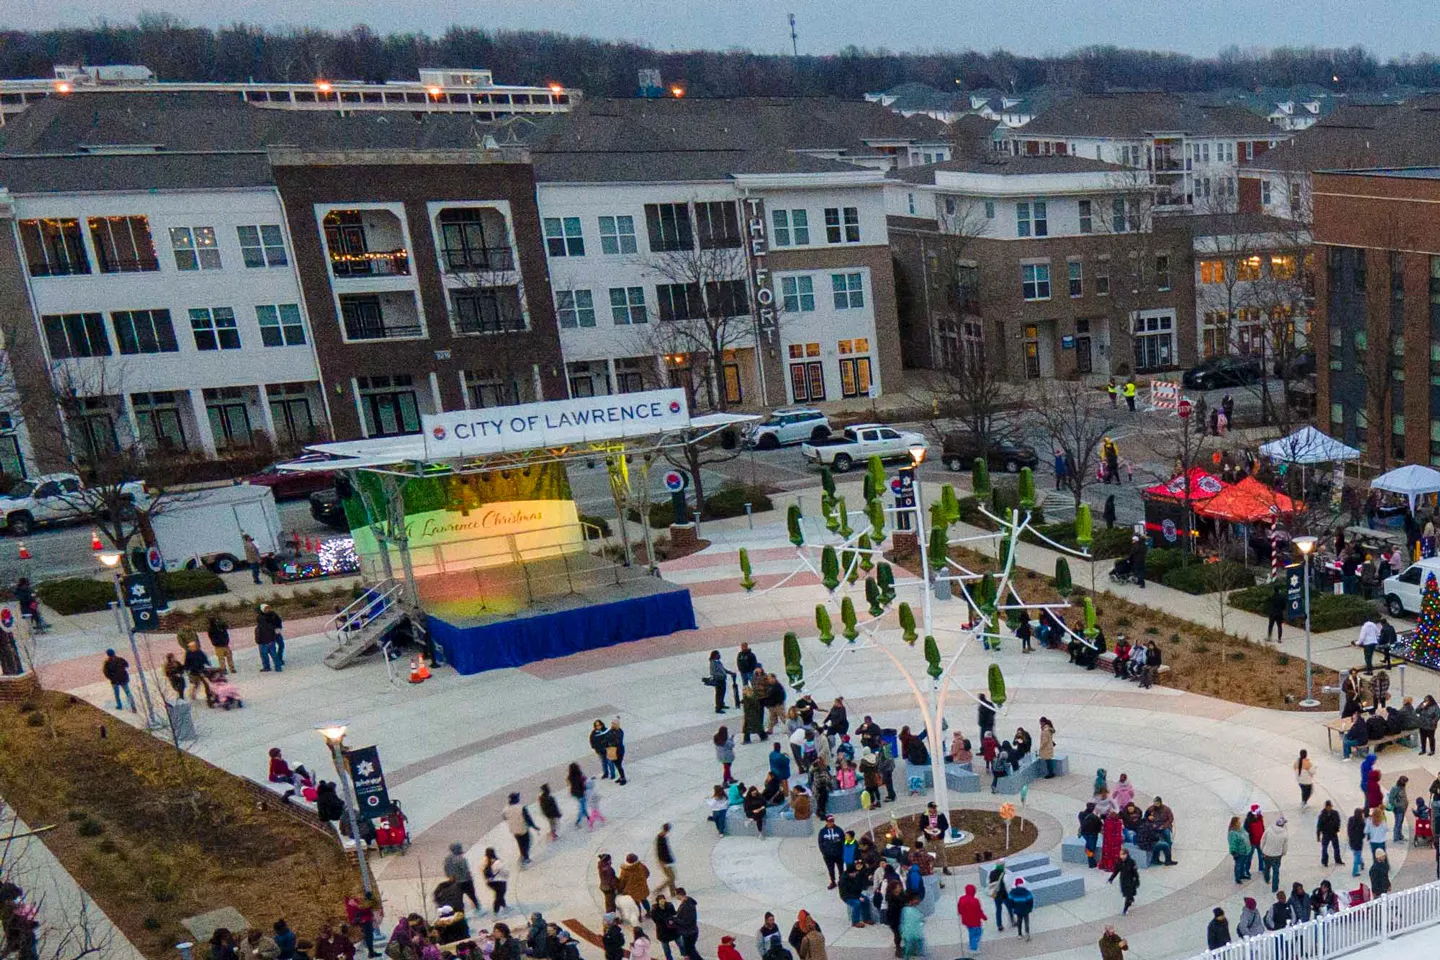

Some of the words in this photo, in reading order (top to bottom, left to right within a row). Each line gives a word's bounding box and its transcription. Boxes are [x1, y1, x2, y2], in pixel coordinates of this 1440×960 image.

[747, 199, 766, 256] THE
[756, 269, 775, 344] FORT
[454, 419, 503, 439] CITY
[510, 416, 539, 433] OF
[545, 402, 663, 429] LAWRENCE
[422, 518, 481, 538] Lawrence
[482, 510, 543, 529] Christmas
